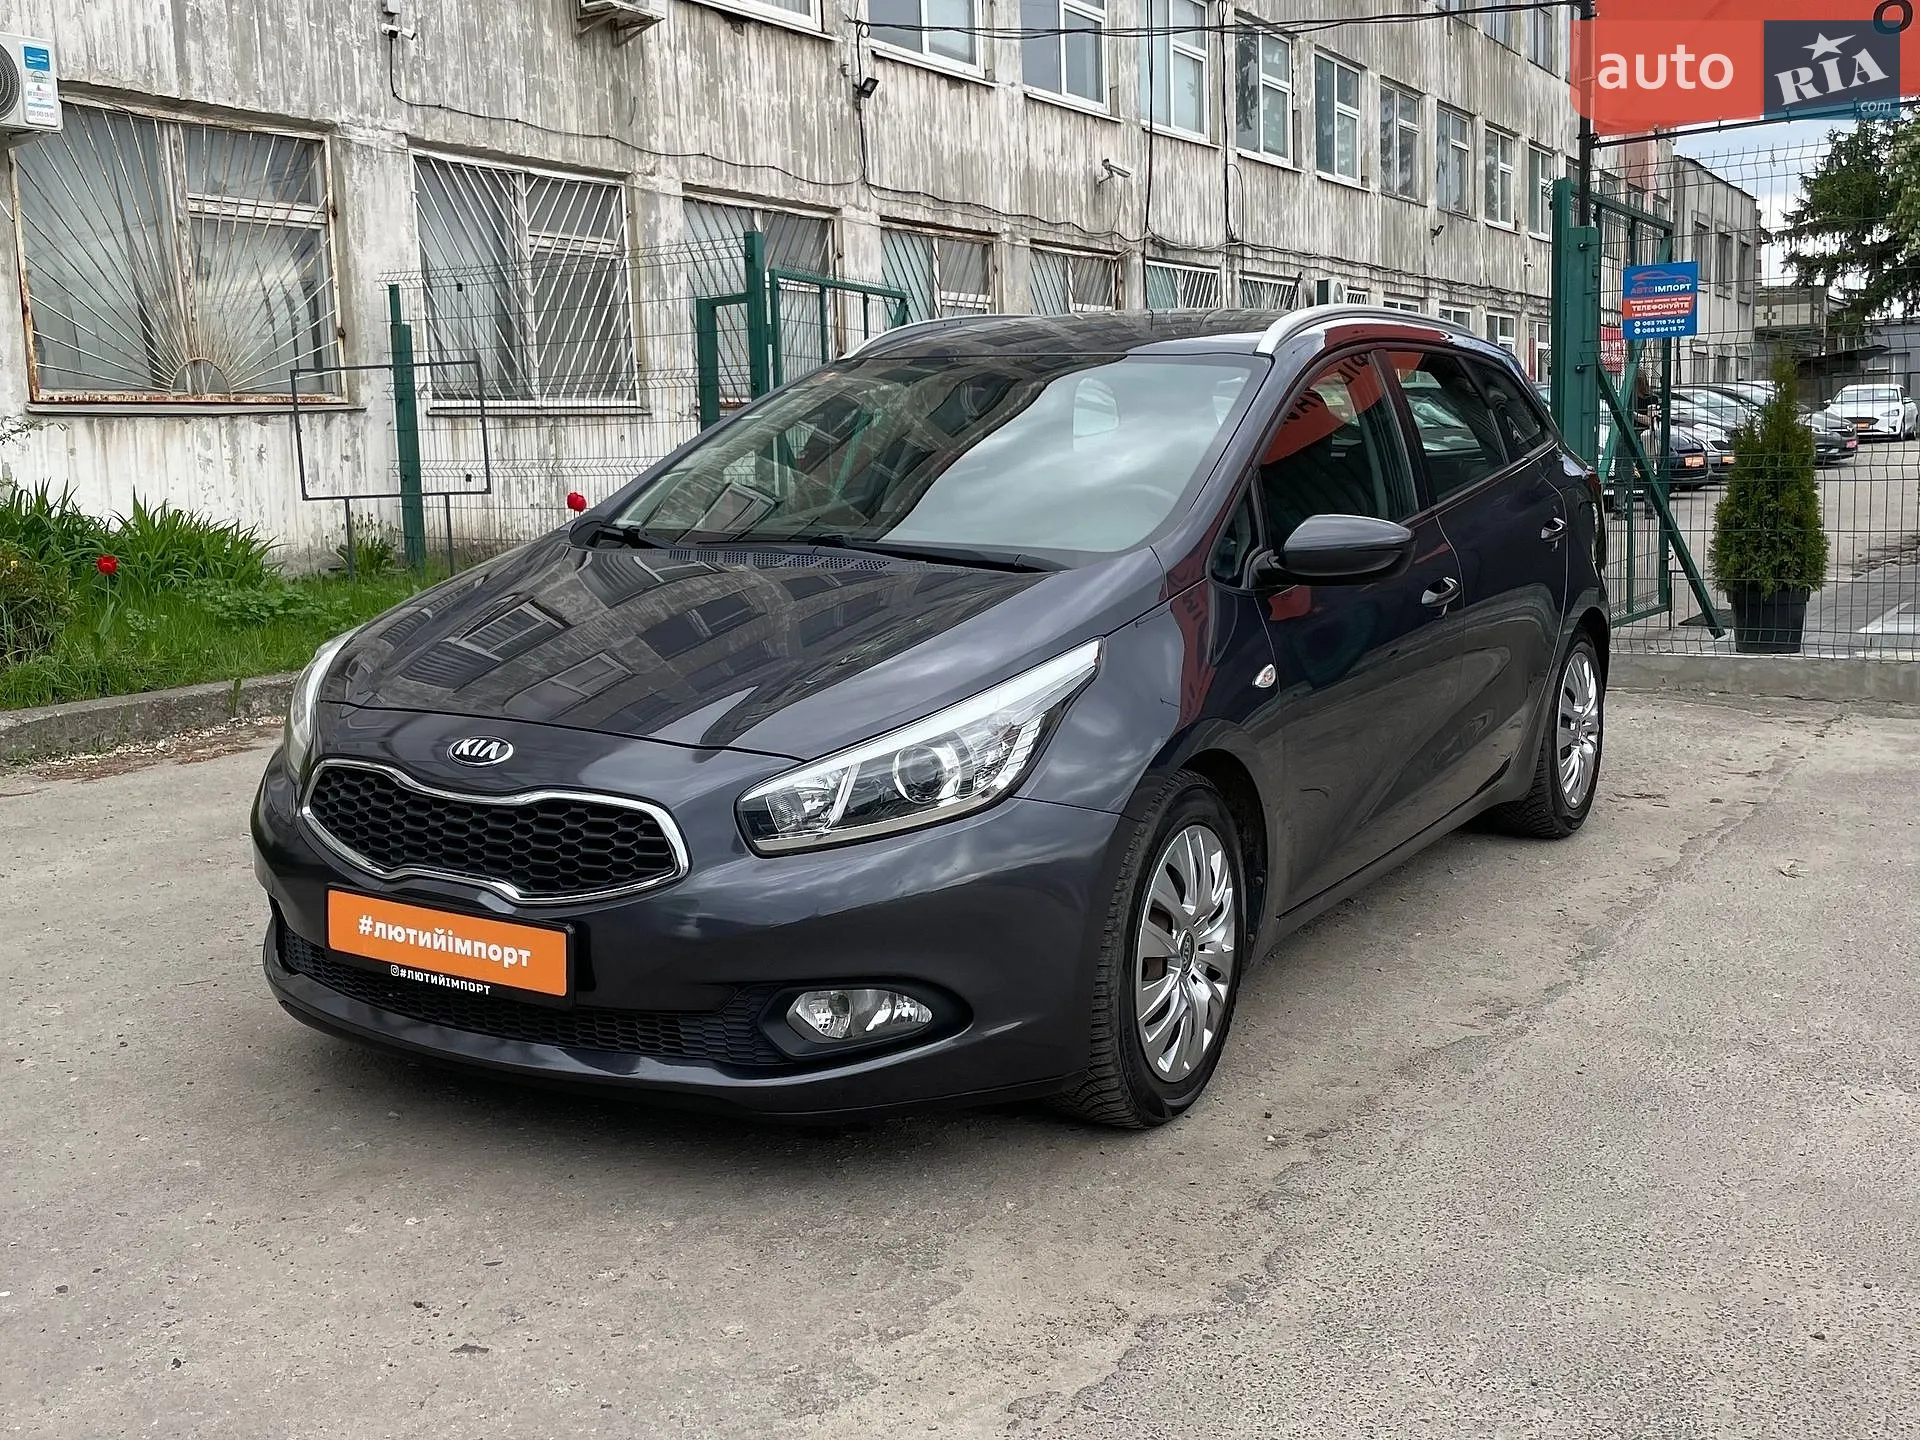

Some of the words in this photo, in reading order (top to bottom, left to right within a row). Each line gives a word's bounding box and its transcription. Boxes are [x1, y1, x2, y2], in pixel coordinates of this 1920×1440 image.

[1632, 302, 1689, 311] ТЕЛЕФОНУЙТЕ
[455, 738, 500, 759] KIA
[358, 914, 532, 969] #лютийімпорт
